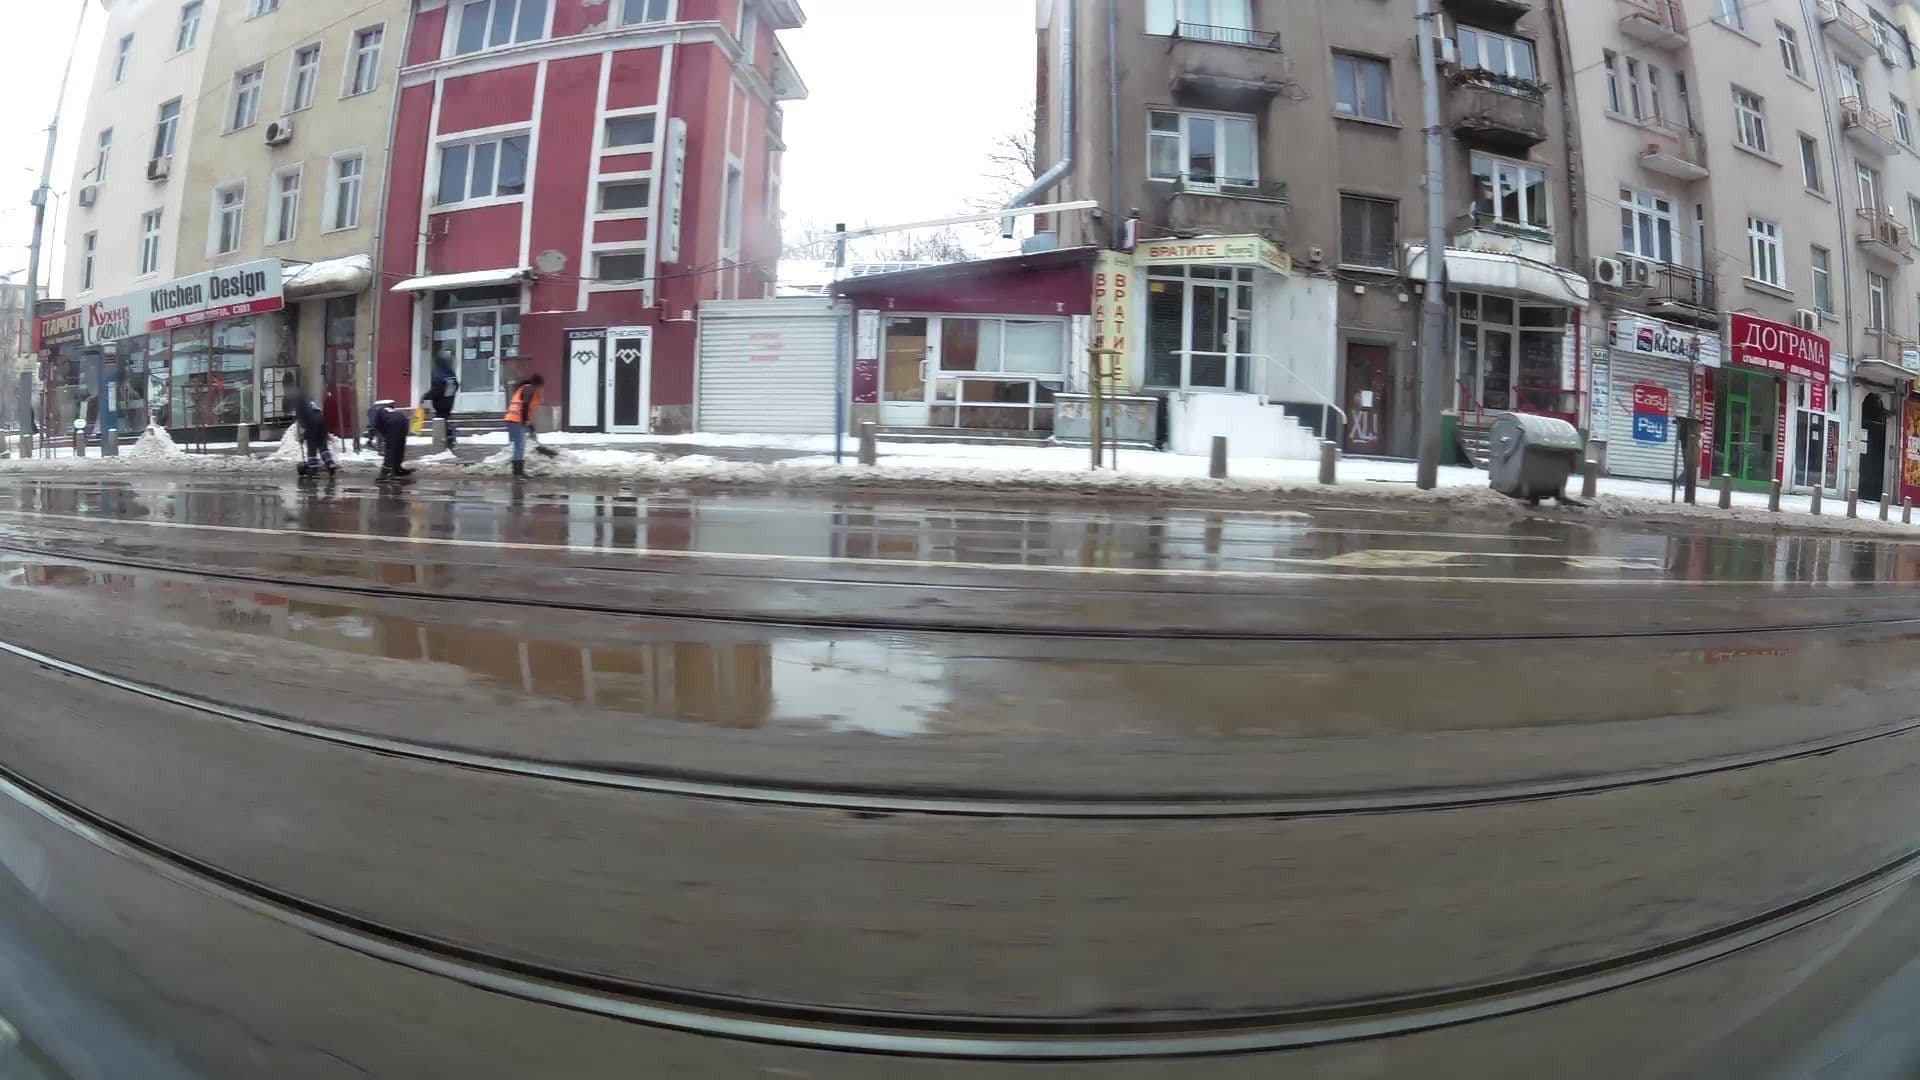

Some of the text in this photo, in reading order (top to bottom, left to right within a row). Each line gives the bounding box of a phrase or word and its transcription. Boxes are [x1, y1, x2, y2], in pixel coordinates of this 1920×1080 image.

[1149, 244, 1217, 257] ВРАТИТЕ
[150, 270, 266, 314] Kitchen Design
[88, 302, 130, 328] Кухни
[1740, 323, 1826, 366] ДОГРАМА
[1634, 388, 1668, 412] Easy
[1638, 417, 1663, 439] Pay
